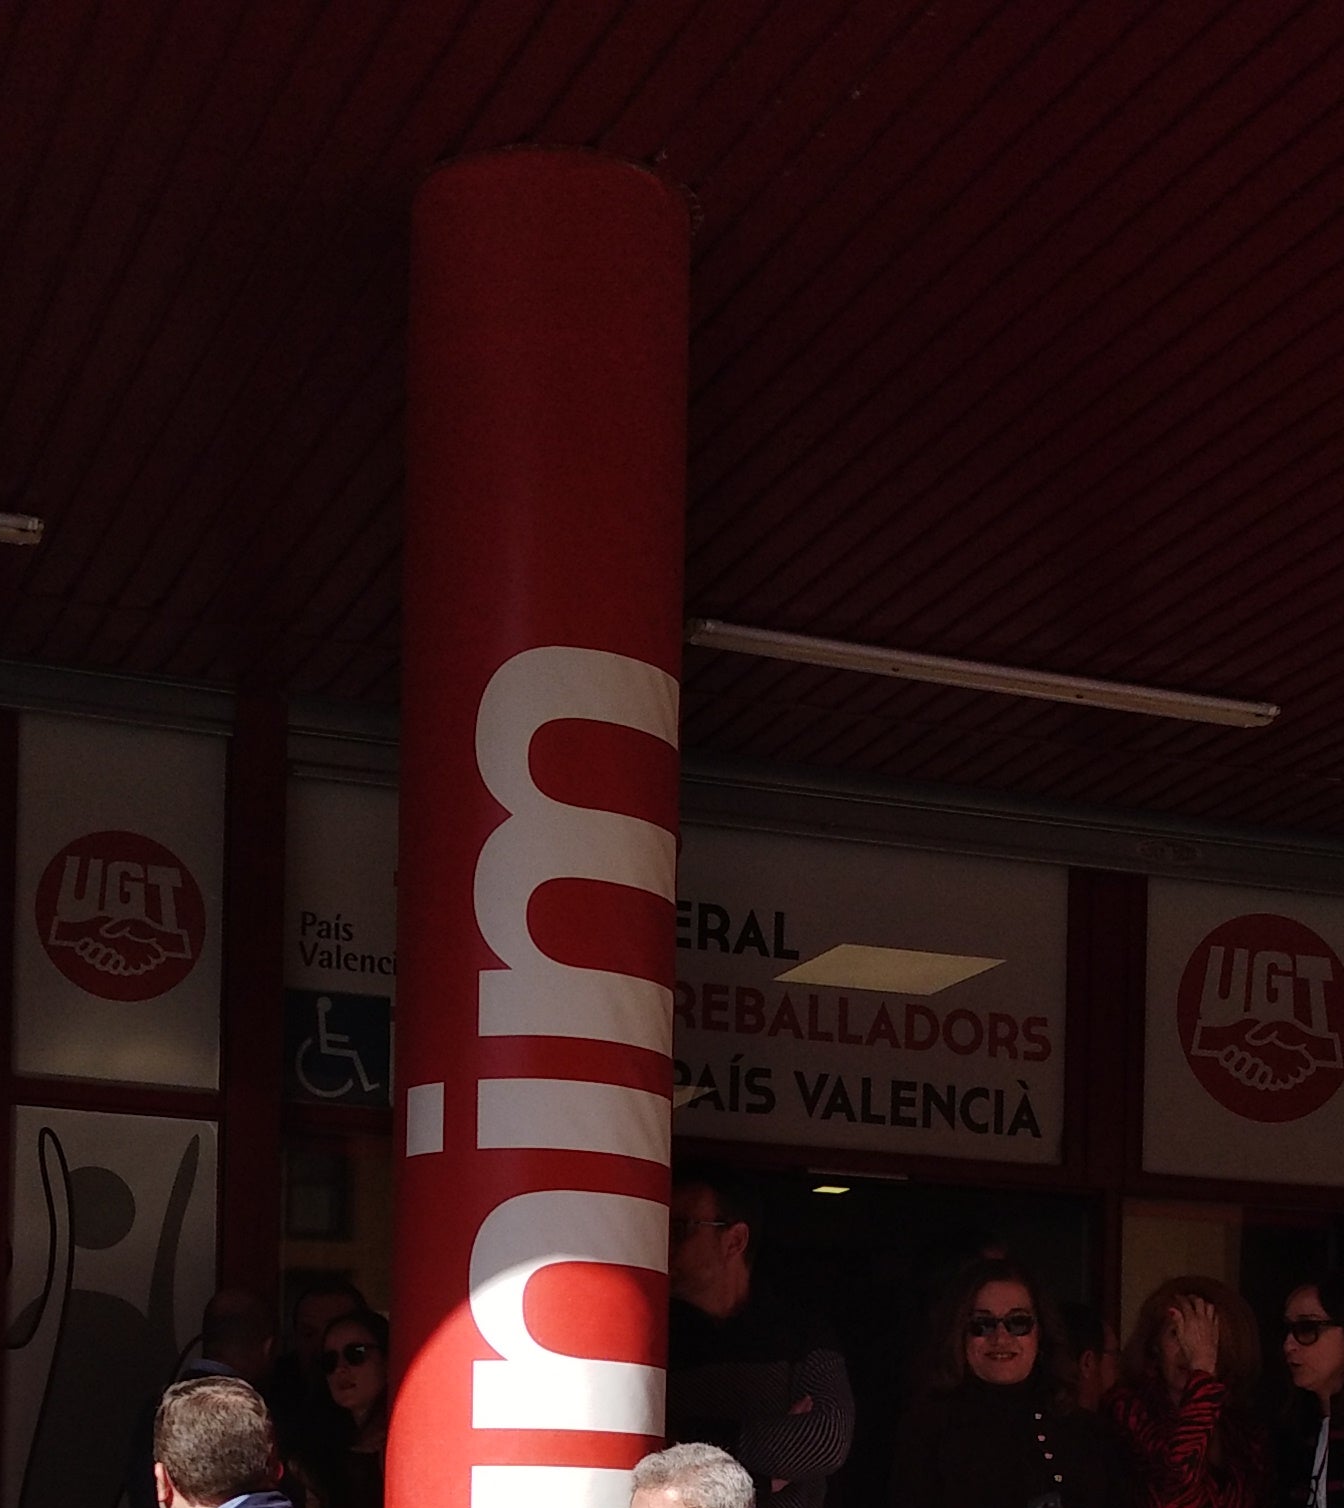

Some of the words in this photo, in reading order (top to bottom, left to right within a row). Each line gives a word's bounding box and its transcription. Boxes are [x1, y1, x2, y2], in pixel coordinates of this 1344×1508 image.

[55, 855, 182, 930] UGT
[299, 941, 397, 975] Valenci
[301, 913, 353, 941] País
[676, 901, 799, 961] ERAL
[674, 980, 1051, 1062] REBALLADORS
[1198, 944, 1335, 1034] UGT
[794, 1071, 1041, 1138] VALENCIÀ
